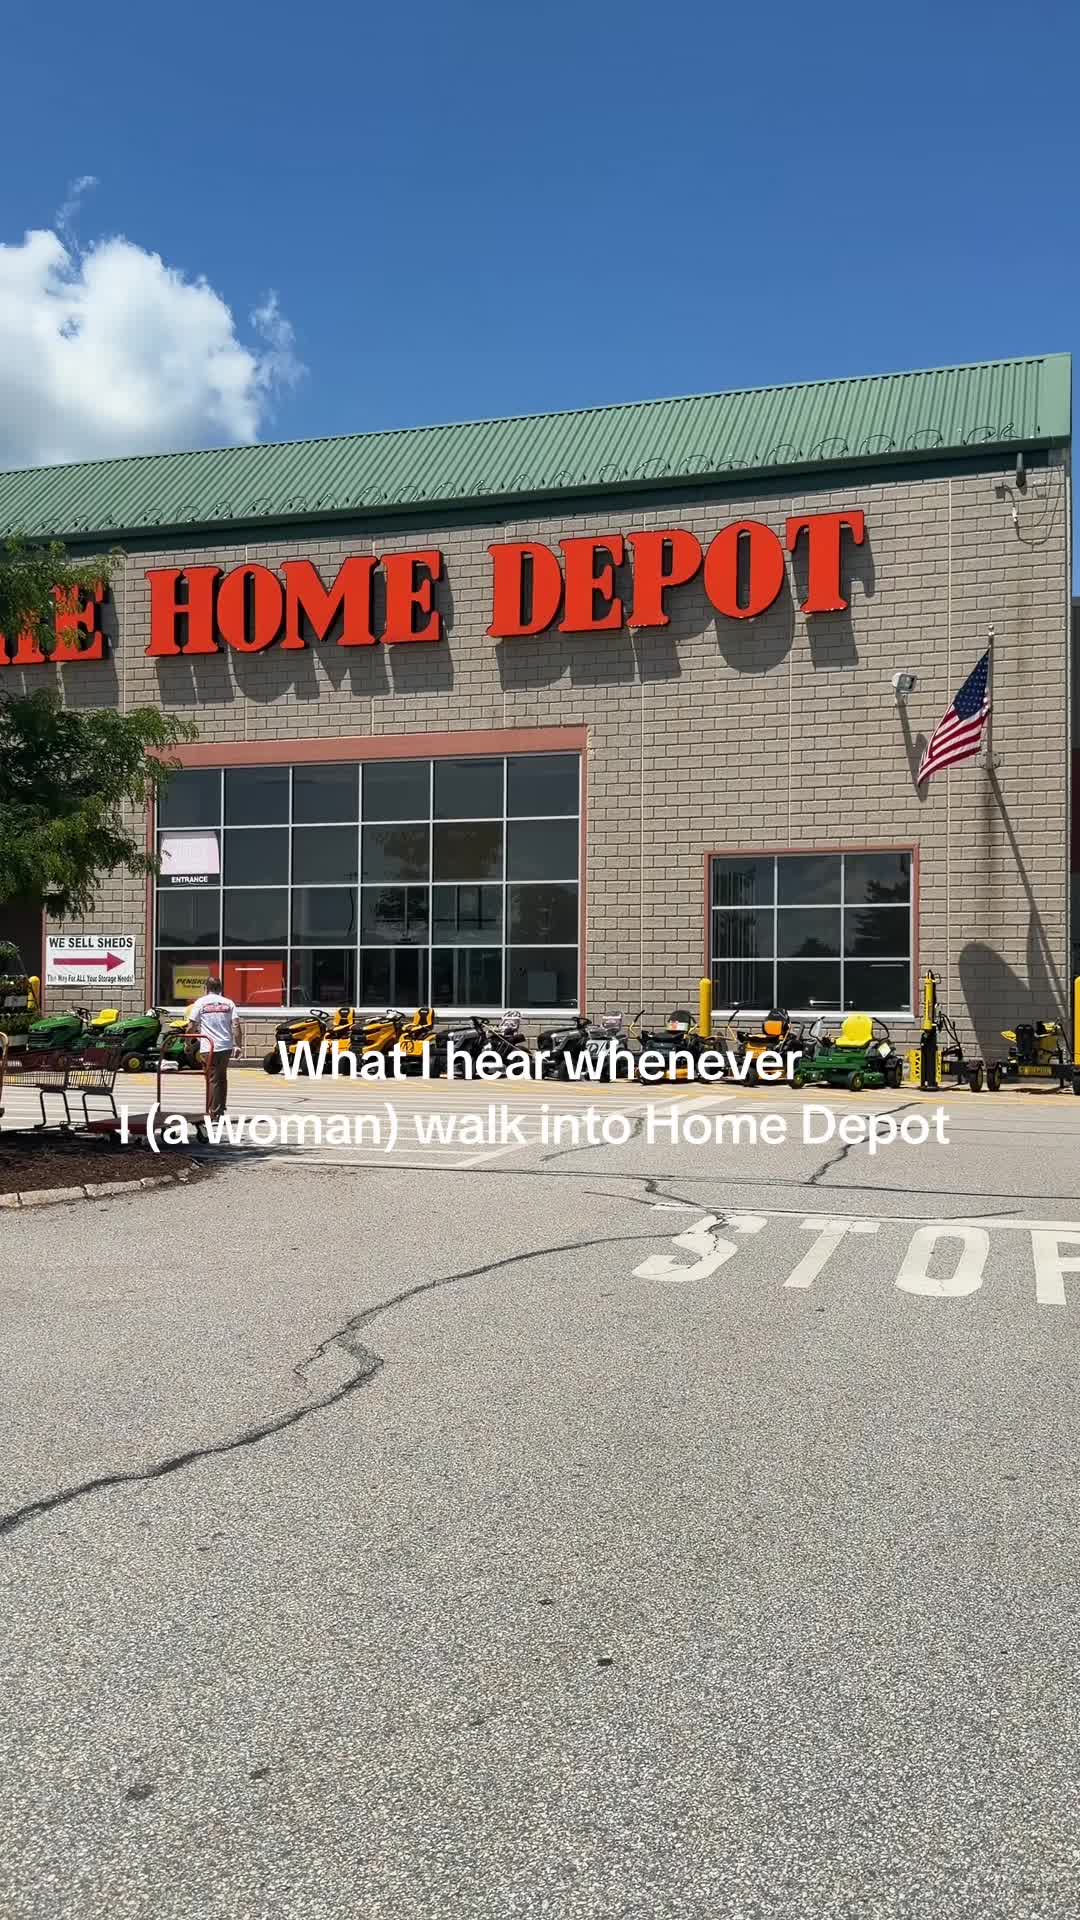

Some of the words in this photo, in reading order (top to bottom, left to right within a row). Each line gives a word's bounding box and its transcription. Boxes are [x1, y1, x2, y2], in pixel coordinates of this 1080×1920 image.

[145, 550, 443, 657] HOME
[486, 510, 865, 637] DEPOT
[171, 875, 209, 884] ENTRANCE
[49, 937, 65, 948] WE
[68, 937, 94, 948] SELL
[98, 937, 133, 948] SHEDS
[68, 974, 76, 982] For
[77, 974, 86, 982] ALL
[87, 974, 97, 982] Your
[98, 974, 116, 984] Storage
[117, 974, 133, 982] Needs!
